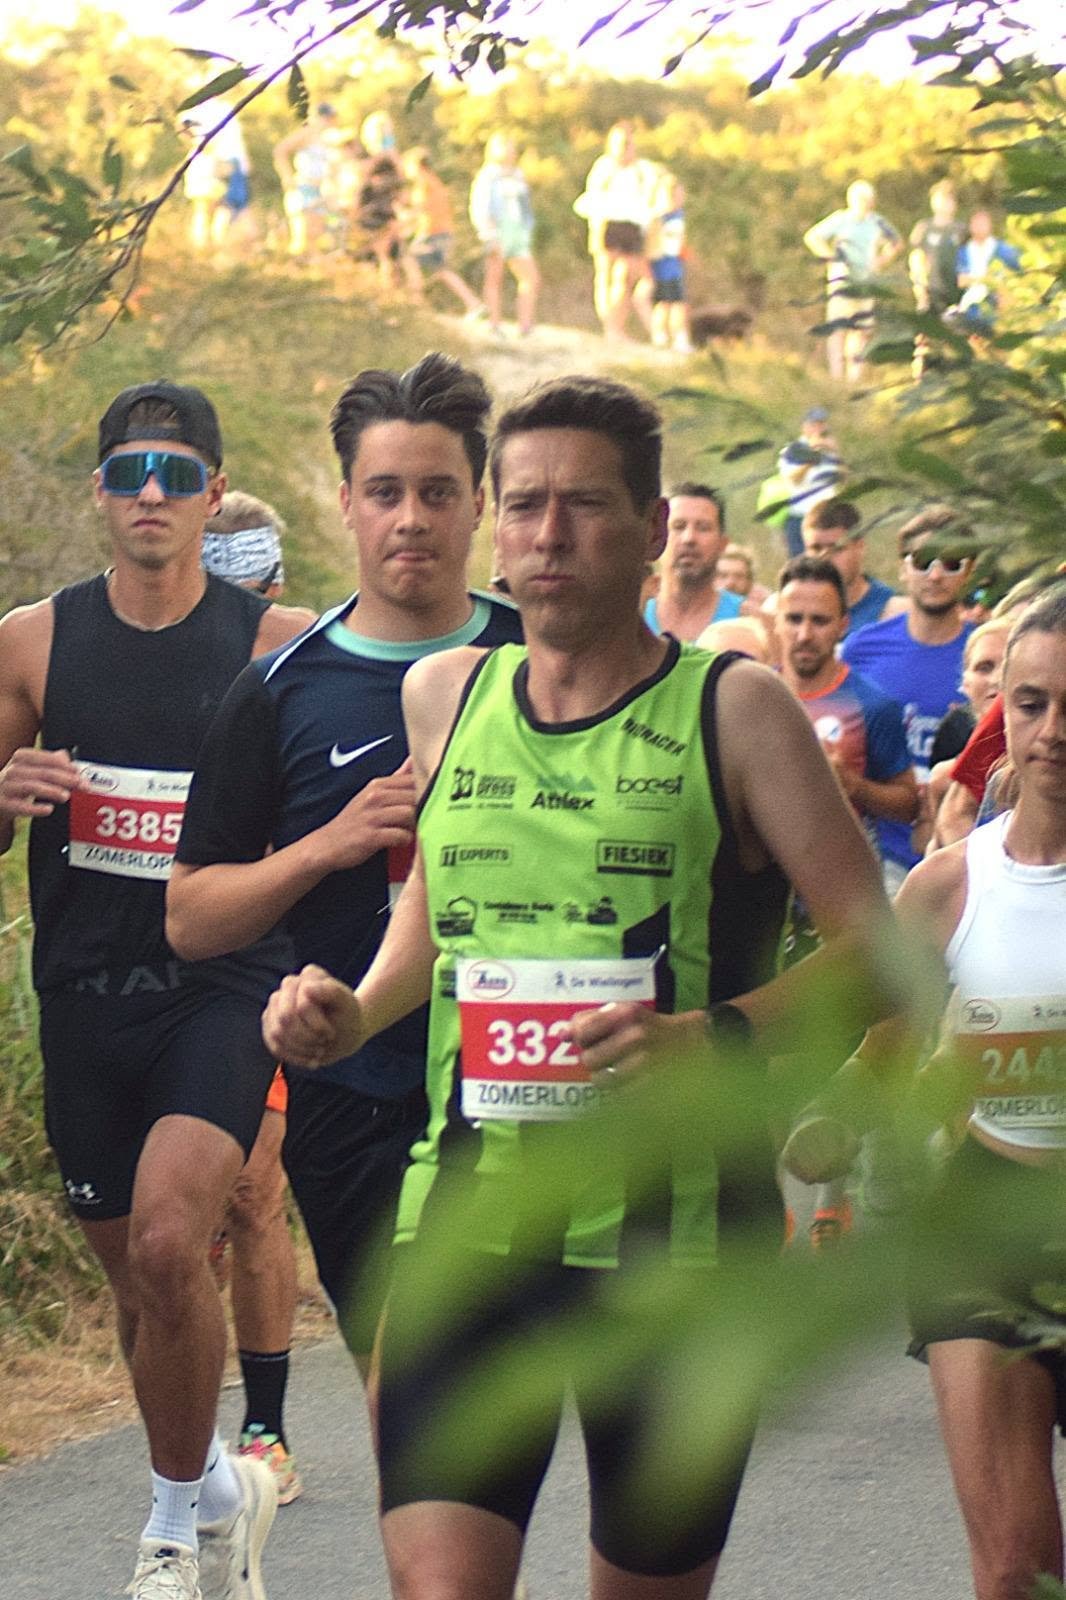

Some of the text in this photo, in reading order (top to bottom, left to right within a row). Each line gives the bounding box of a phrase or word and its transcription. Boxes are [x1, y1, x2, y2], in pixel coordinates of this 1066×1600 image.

[95, 806, 184, 844] 3385
[603, 846, 668, 866] FIESIEK
[478, 1083, 607, 1108] ZOMERLOP
